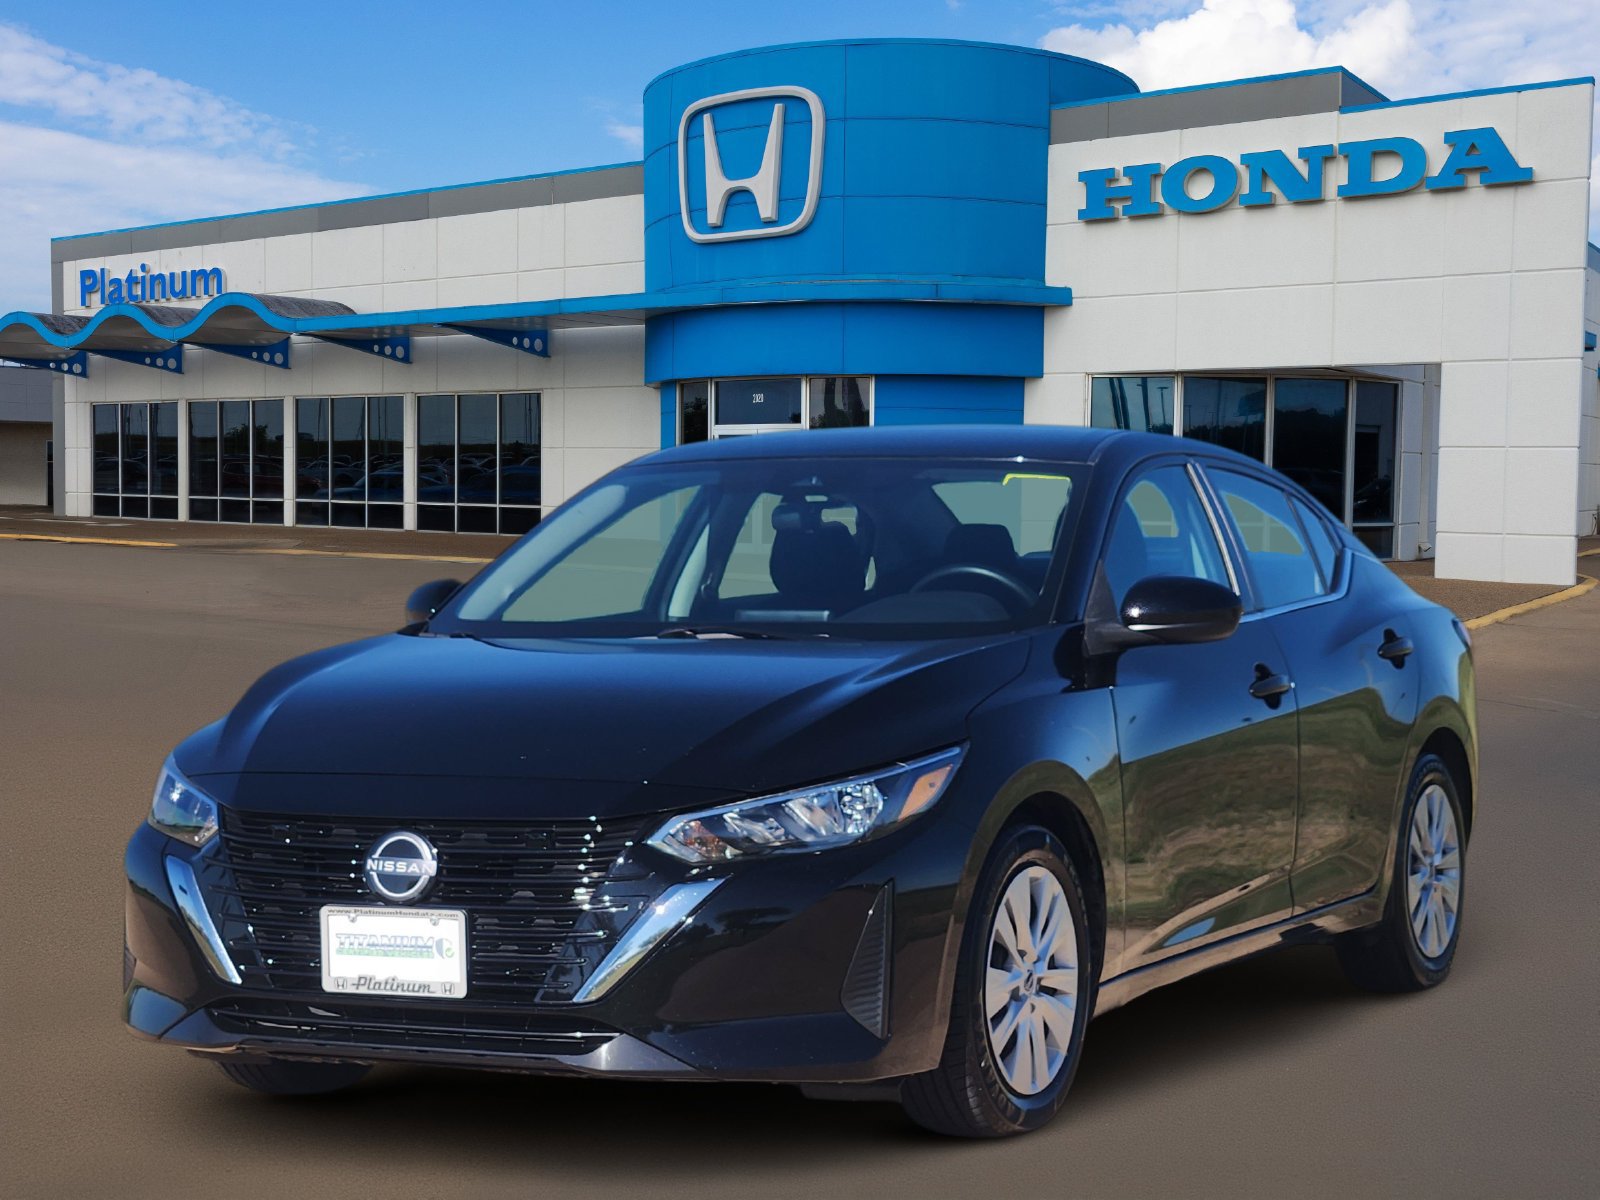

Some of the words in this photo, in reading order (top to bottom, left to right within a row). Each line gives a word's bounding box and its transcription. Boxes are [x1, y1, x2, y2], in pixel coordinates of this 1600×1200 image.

[1077, 126, 1534, 221] HONDA
[79, 262, 225, 307] Platinum
[366, 858, 434, 876] NISSAN
[351, 976, 436, 994] Platinum
